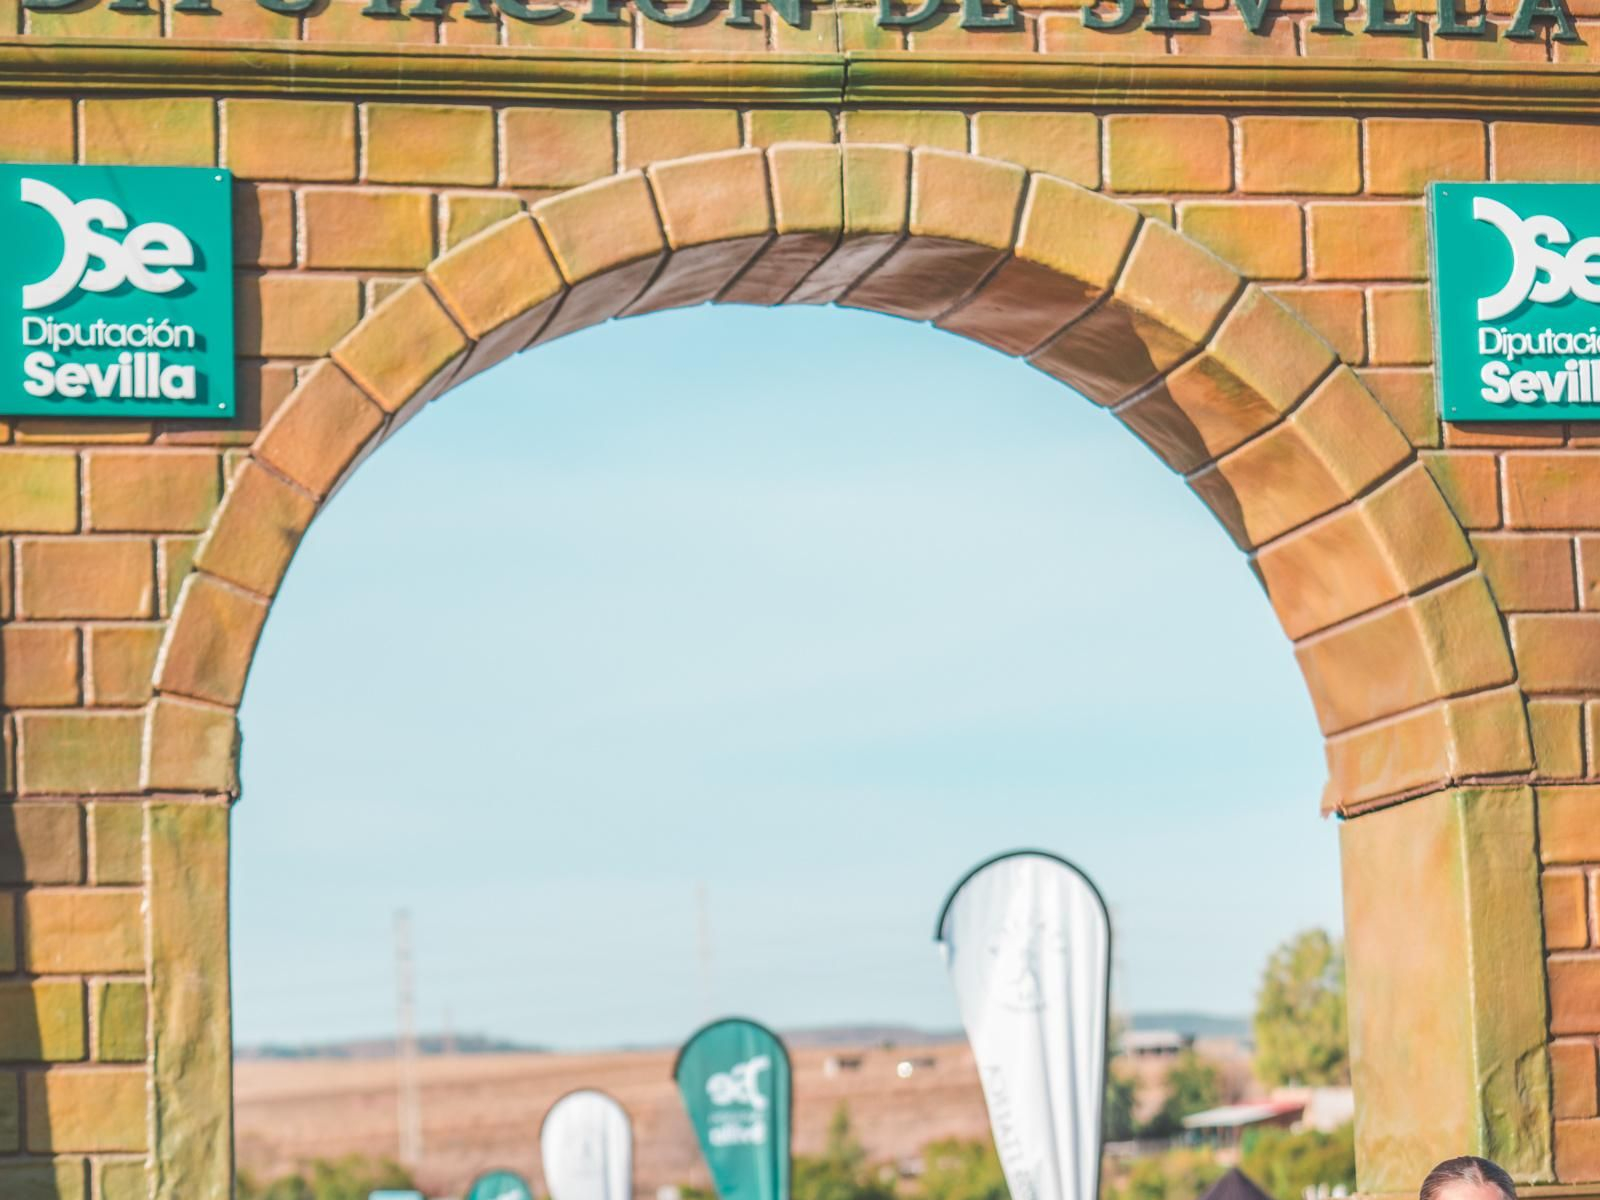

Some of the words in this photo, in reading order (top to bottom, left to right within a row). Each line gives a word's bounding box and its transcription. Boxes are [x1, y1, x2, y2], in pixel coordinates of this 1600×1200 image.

[22, 316, 195, 352] Diputación
[1478, 327, 1600, 361] Diputaci
[23, 351, 196, 400] Sevilla
